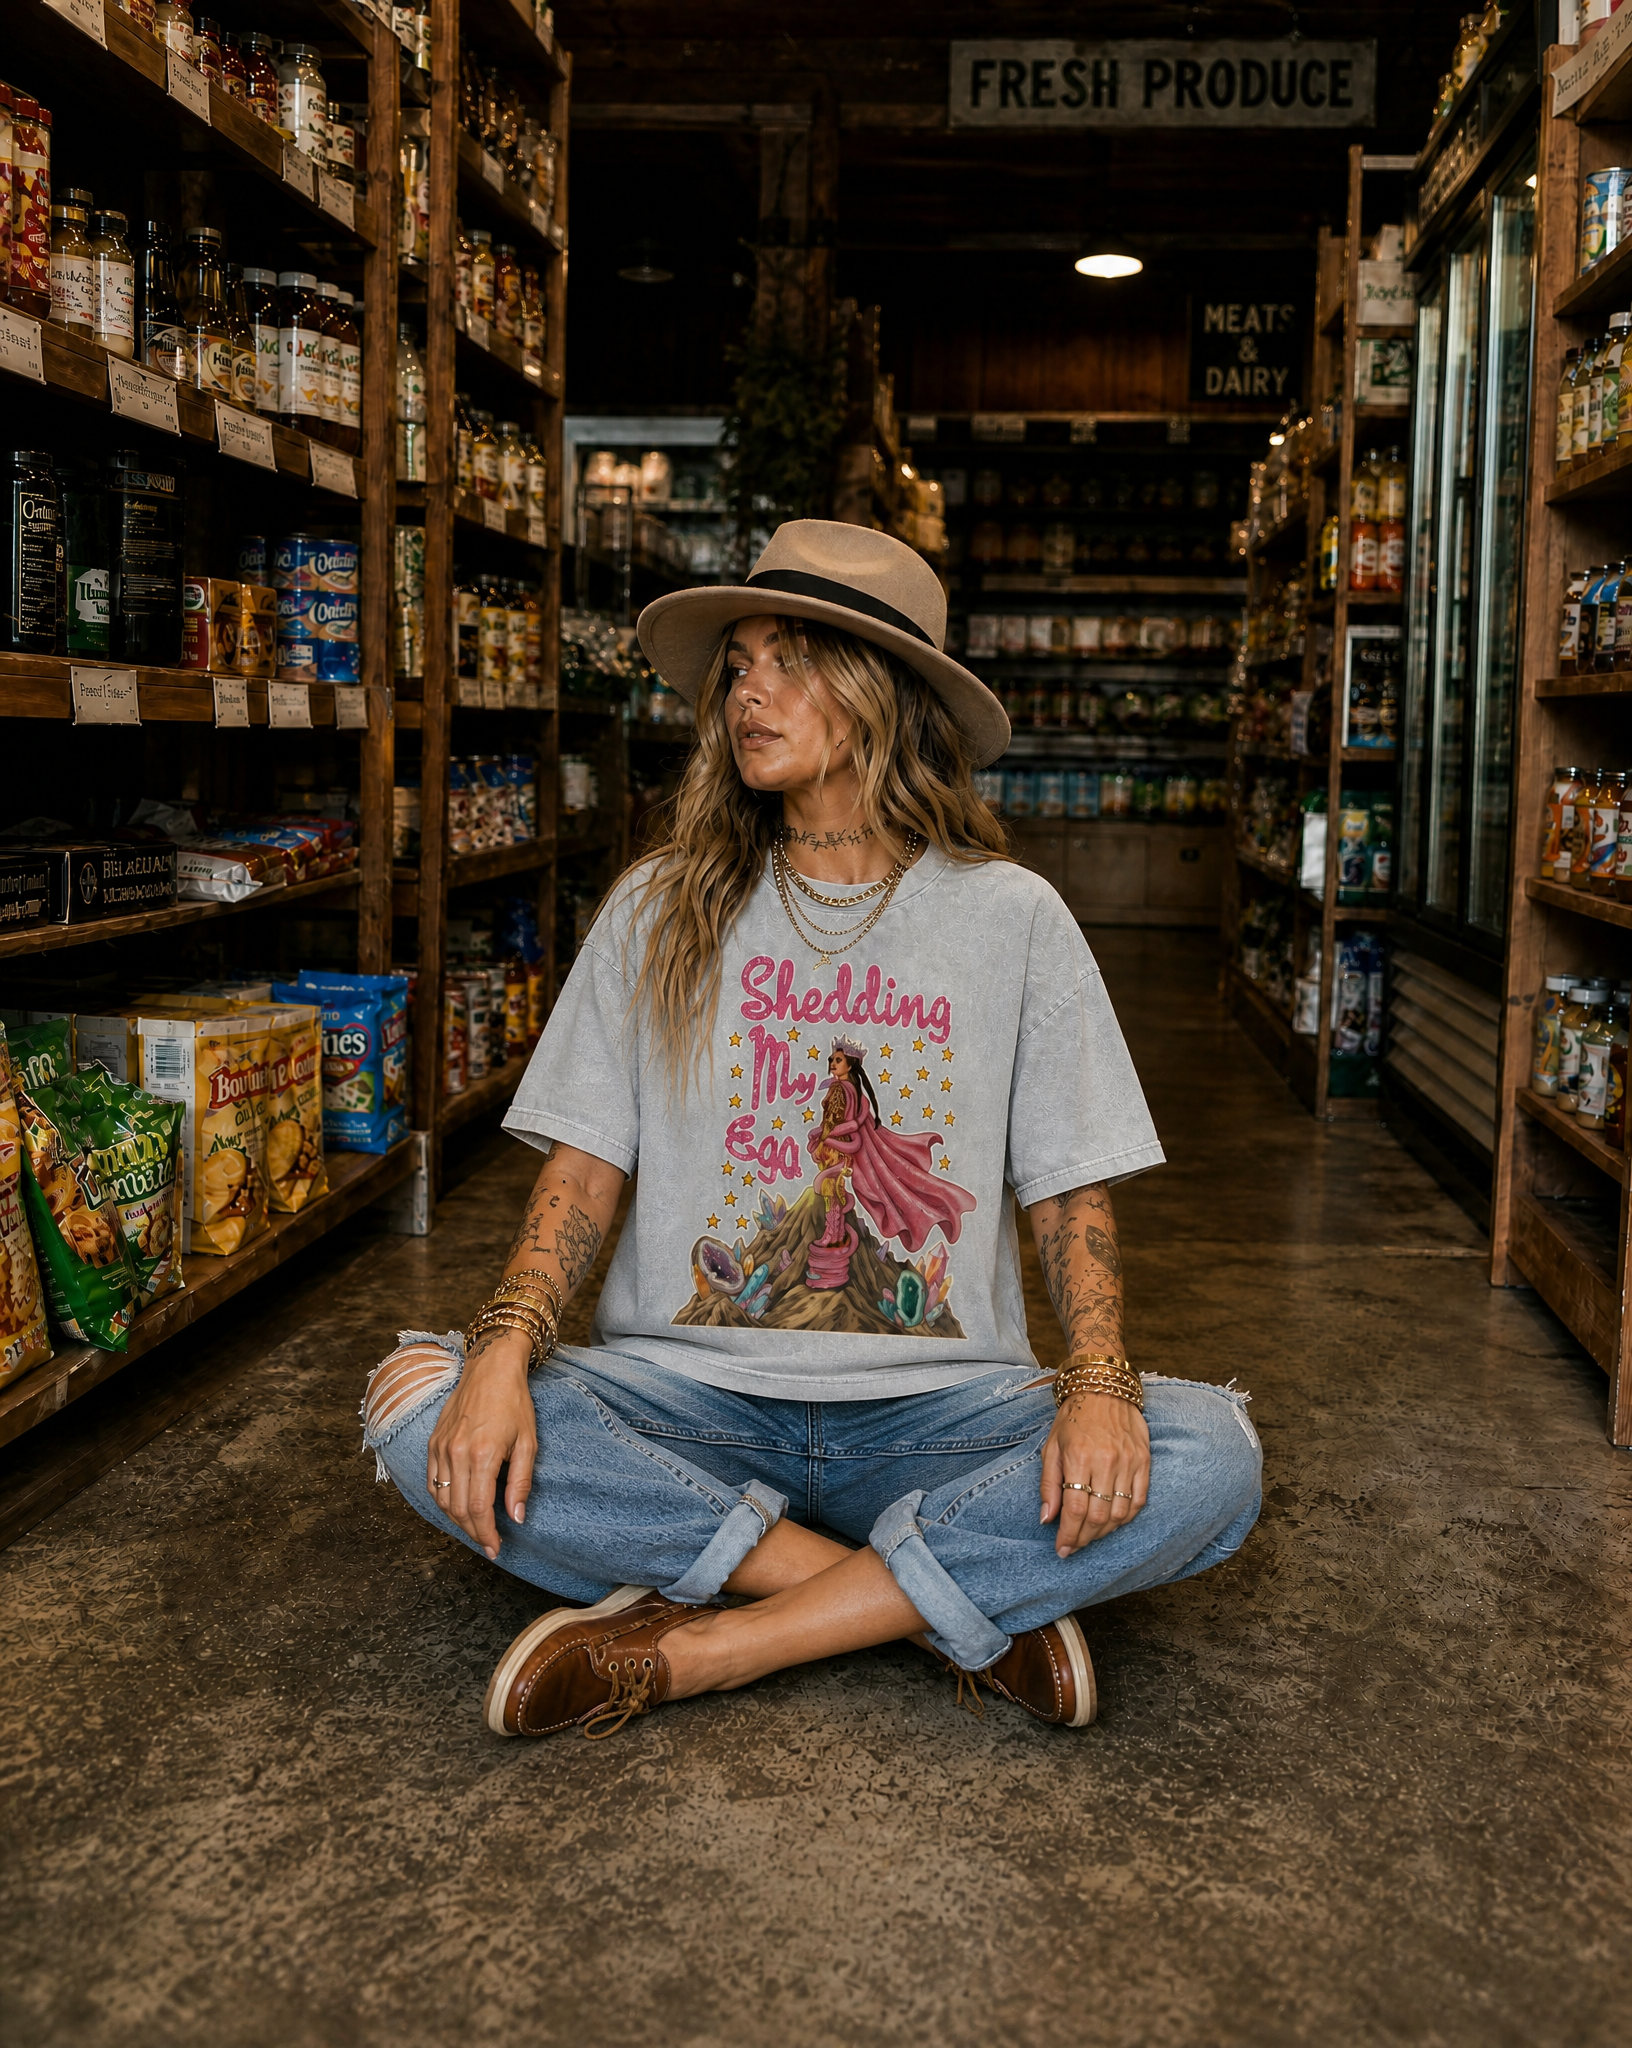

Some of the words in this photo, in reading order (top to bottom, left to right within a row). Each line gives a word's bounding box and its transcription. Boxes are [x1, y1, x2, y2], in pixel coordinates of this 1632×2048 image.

[969, 58, 1119, 108] FRESH
[1143, 58, 1354, 109] PRODUCE
[1203, 303, 1297, 334] MEATS
[1237, 335, 1259, 363] &
[1205, 366, 1290, 396] DAIRY
[740, 955, 952, 1044] Shedding
[747, 1024, 817, 1111] My
